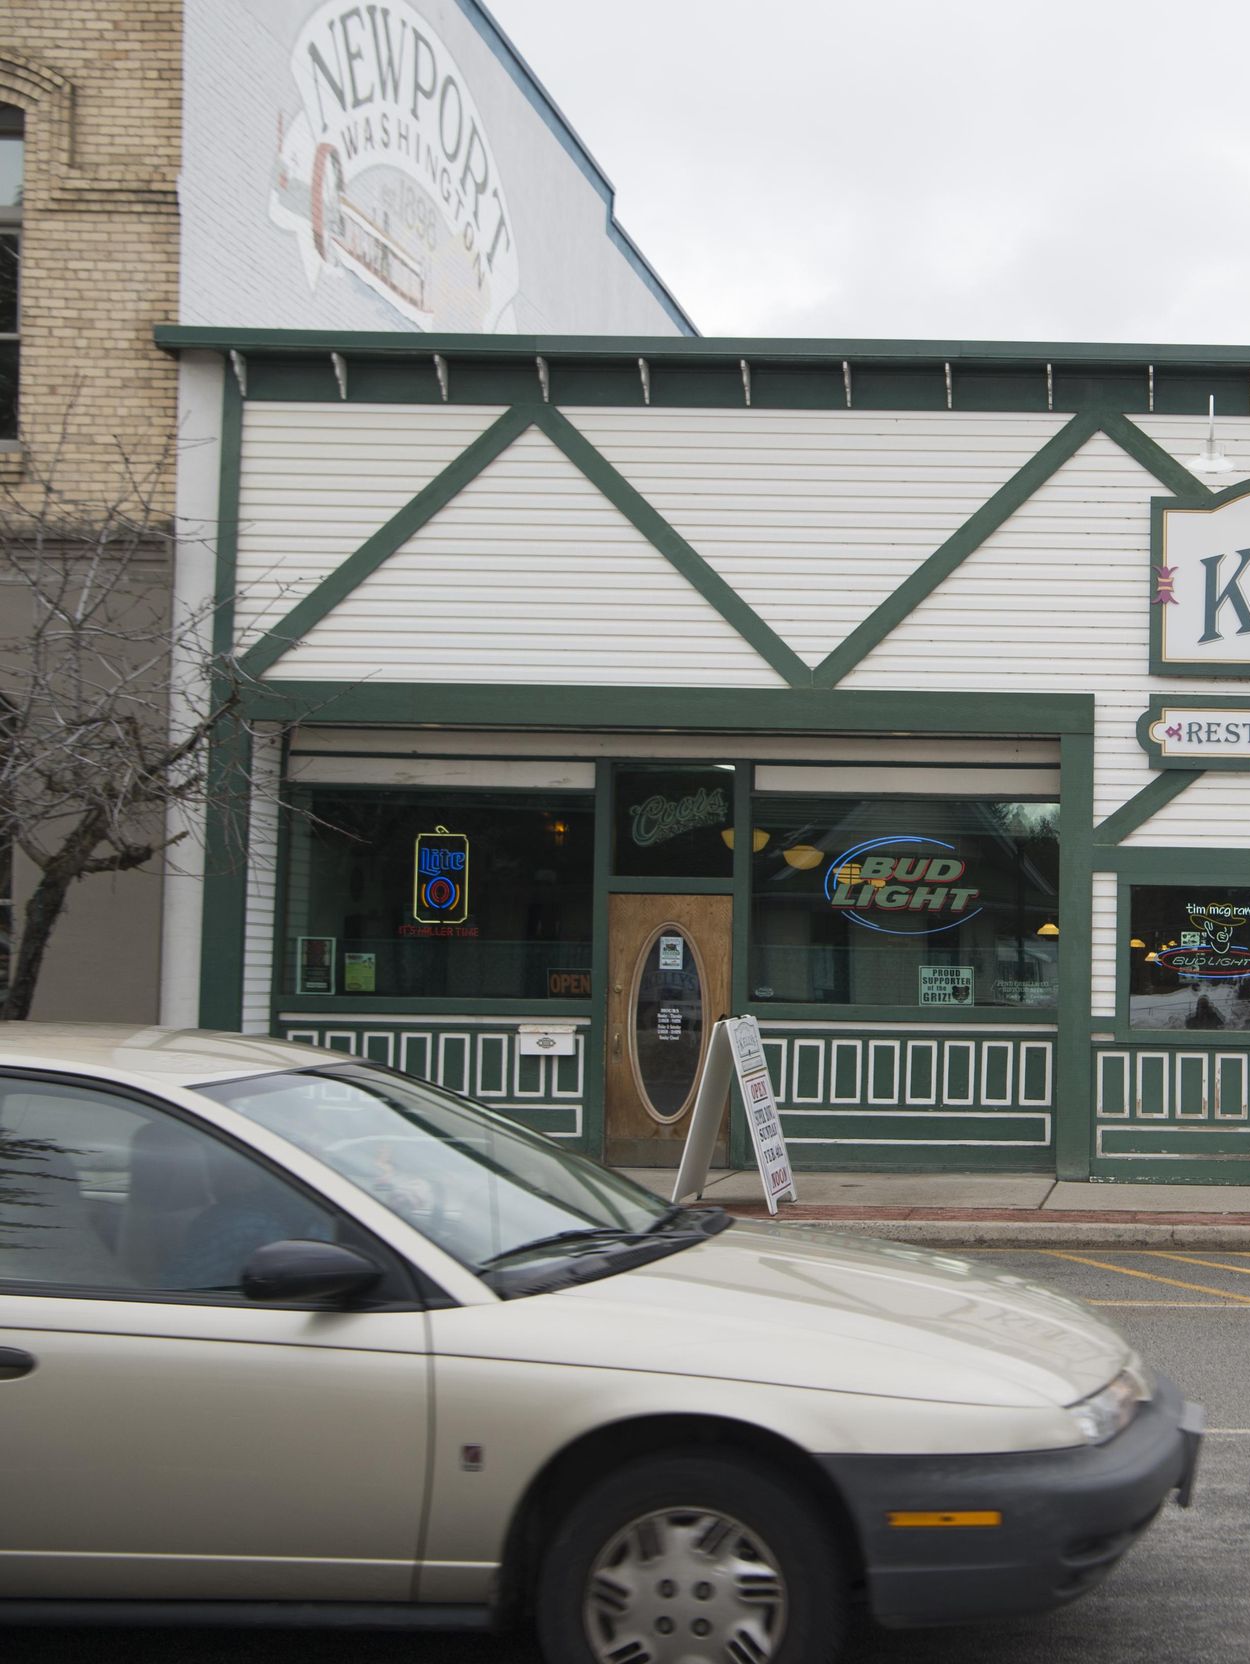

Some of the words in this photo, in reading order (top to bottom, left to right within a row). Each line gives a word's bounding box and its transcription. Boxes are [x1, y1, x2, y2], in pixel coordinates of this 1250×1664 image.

[307, 5, 512, 274] NEWPORT
[340, 112, 487, 291] WASHINGTON
[419, 847, 466, 876] Lite
[860, 856, 966, 883] BUD
[831, 884, 980, 913] LIGHT
[1186, 902, 1206, 915] tim
[1172, 955, 1205, 966] BUD
[922, 976, 971, 985] SUPPORTER
[932, 968, 961, 977] PROUD
[549, 973, 590, 994] OPEN
[923, 992, 952, 1003] GRIZ!
[750, 1081, 767, 1100] OPEN
[771, 1165, 788, 1189] NOON
